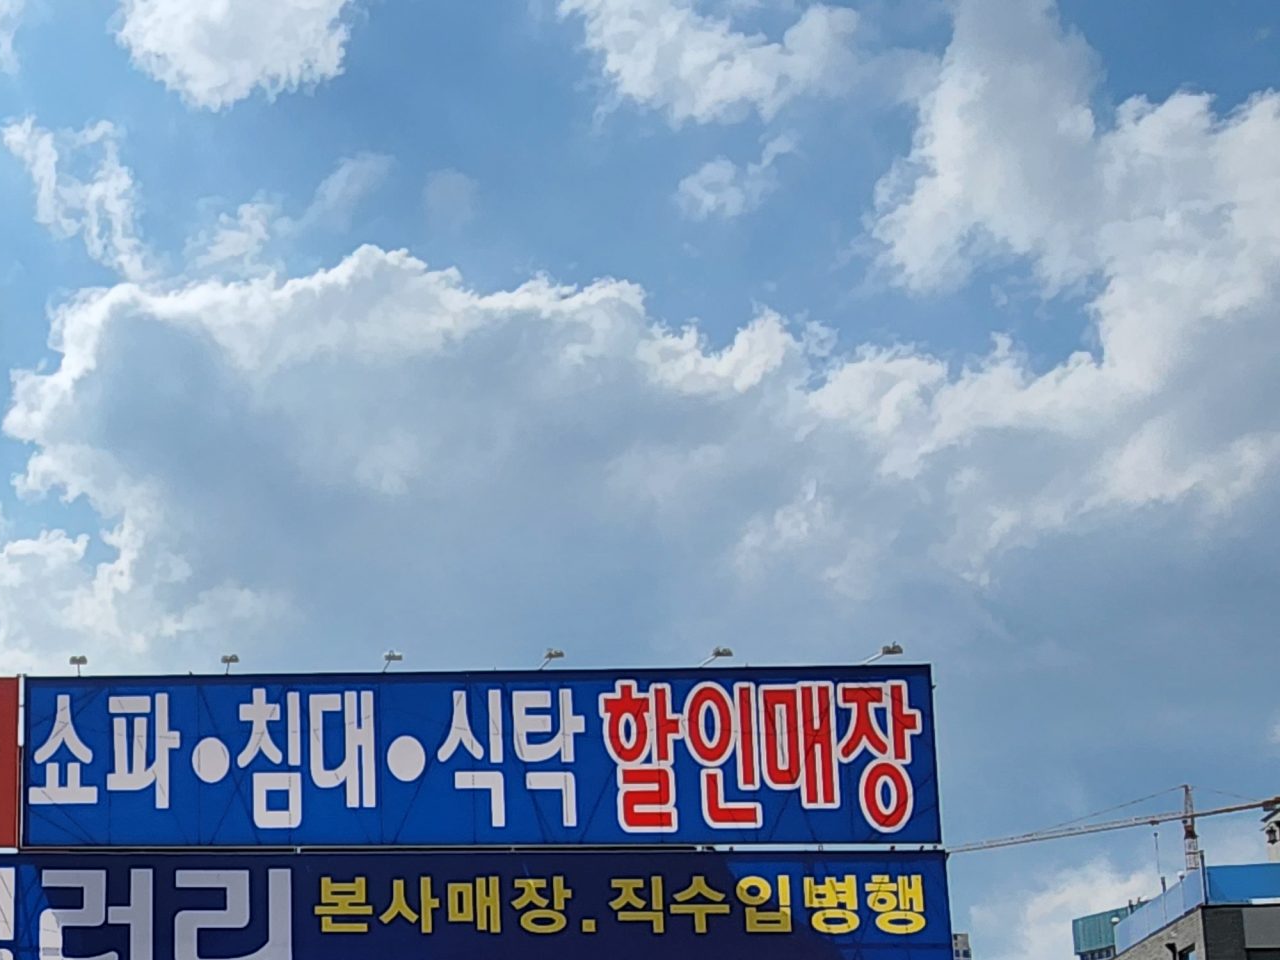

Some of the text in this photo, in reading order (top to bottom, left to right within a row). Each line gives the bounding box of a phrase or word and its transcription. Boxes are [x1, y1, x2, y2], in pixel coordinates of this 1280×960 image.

[28, 678, 924, 834] 쇼파 침대 식탁 할인매장
